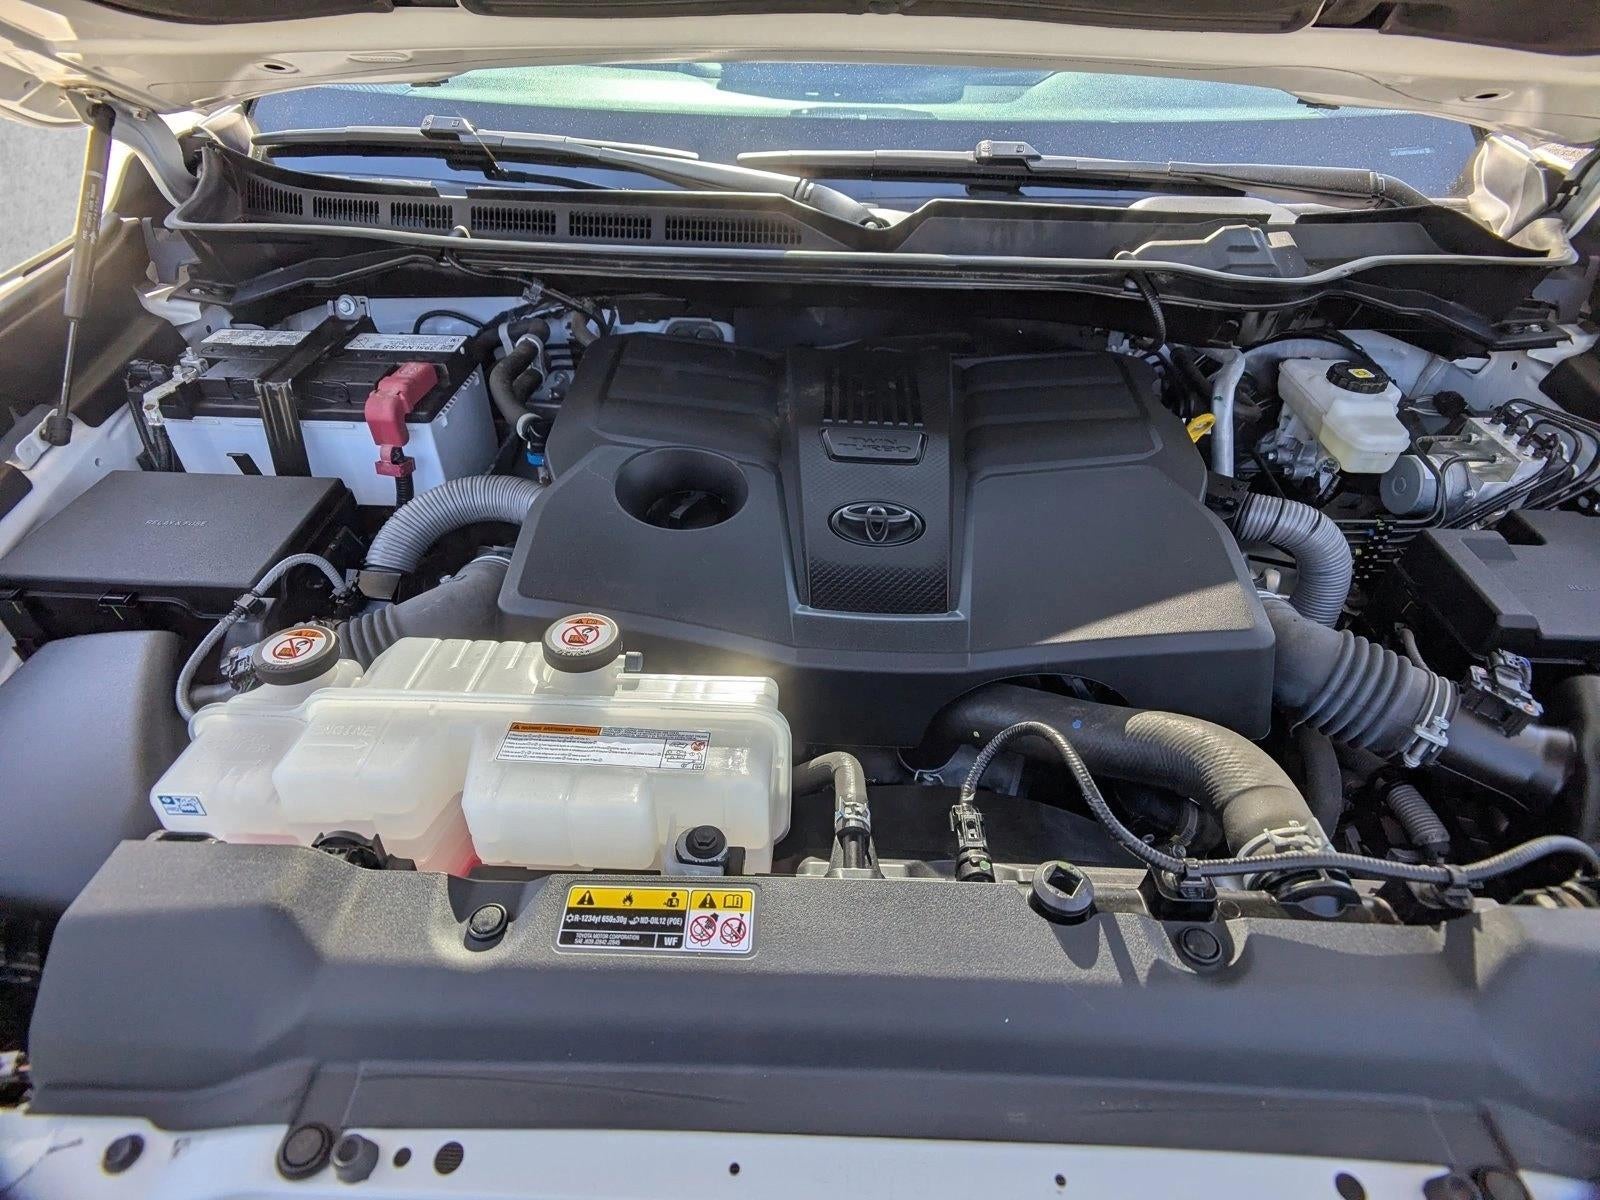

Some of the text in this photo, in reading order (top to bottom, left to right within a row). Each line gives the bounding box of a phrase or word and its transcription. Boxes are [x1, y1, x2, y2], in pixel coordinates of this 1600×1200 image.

[847, 436, 898, 445] TWIN
[838, 443, 912, 453] TURBO
[574, 914, 601, 923] R-1234yf
[664, 937, 678, 946] WF
